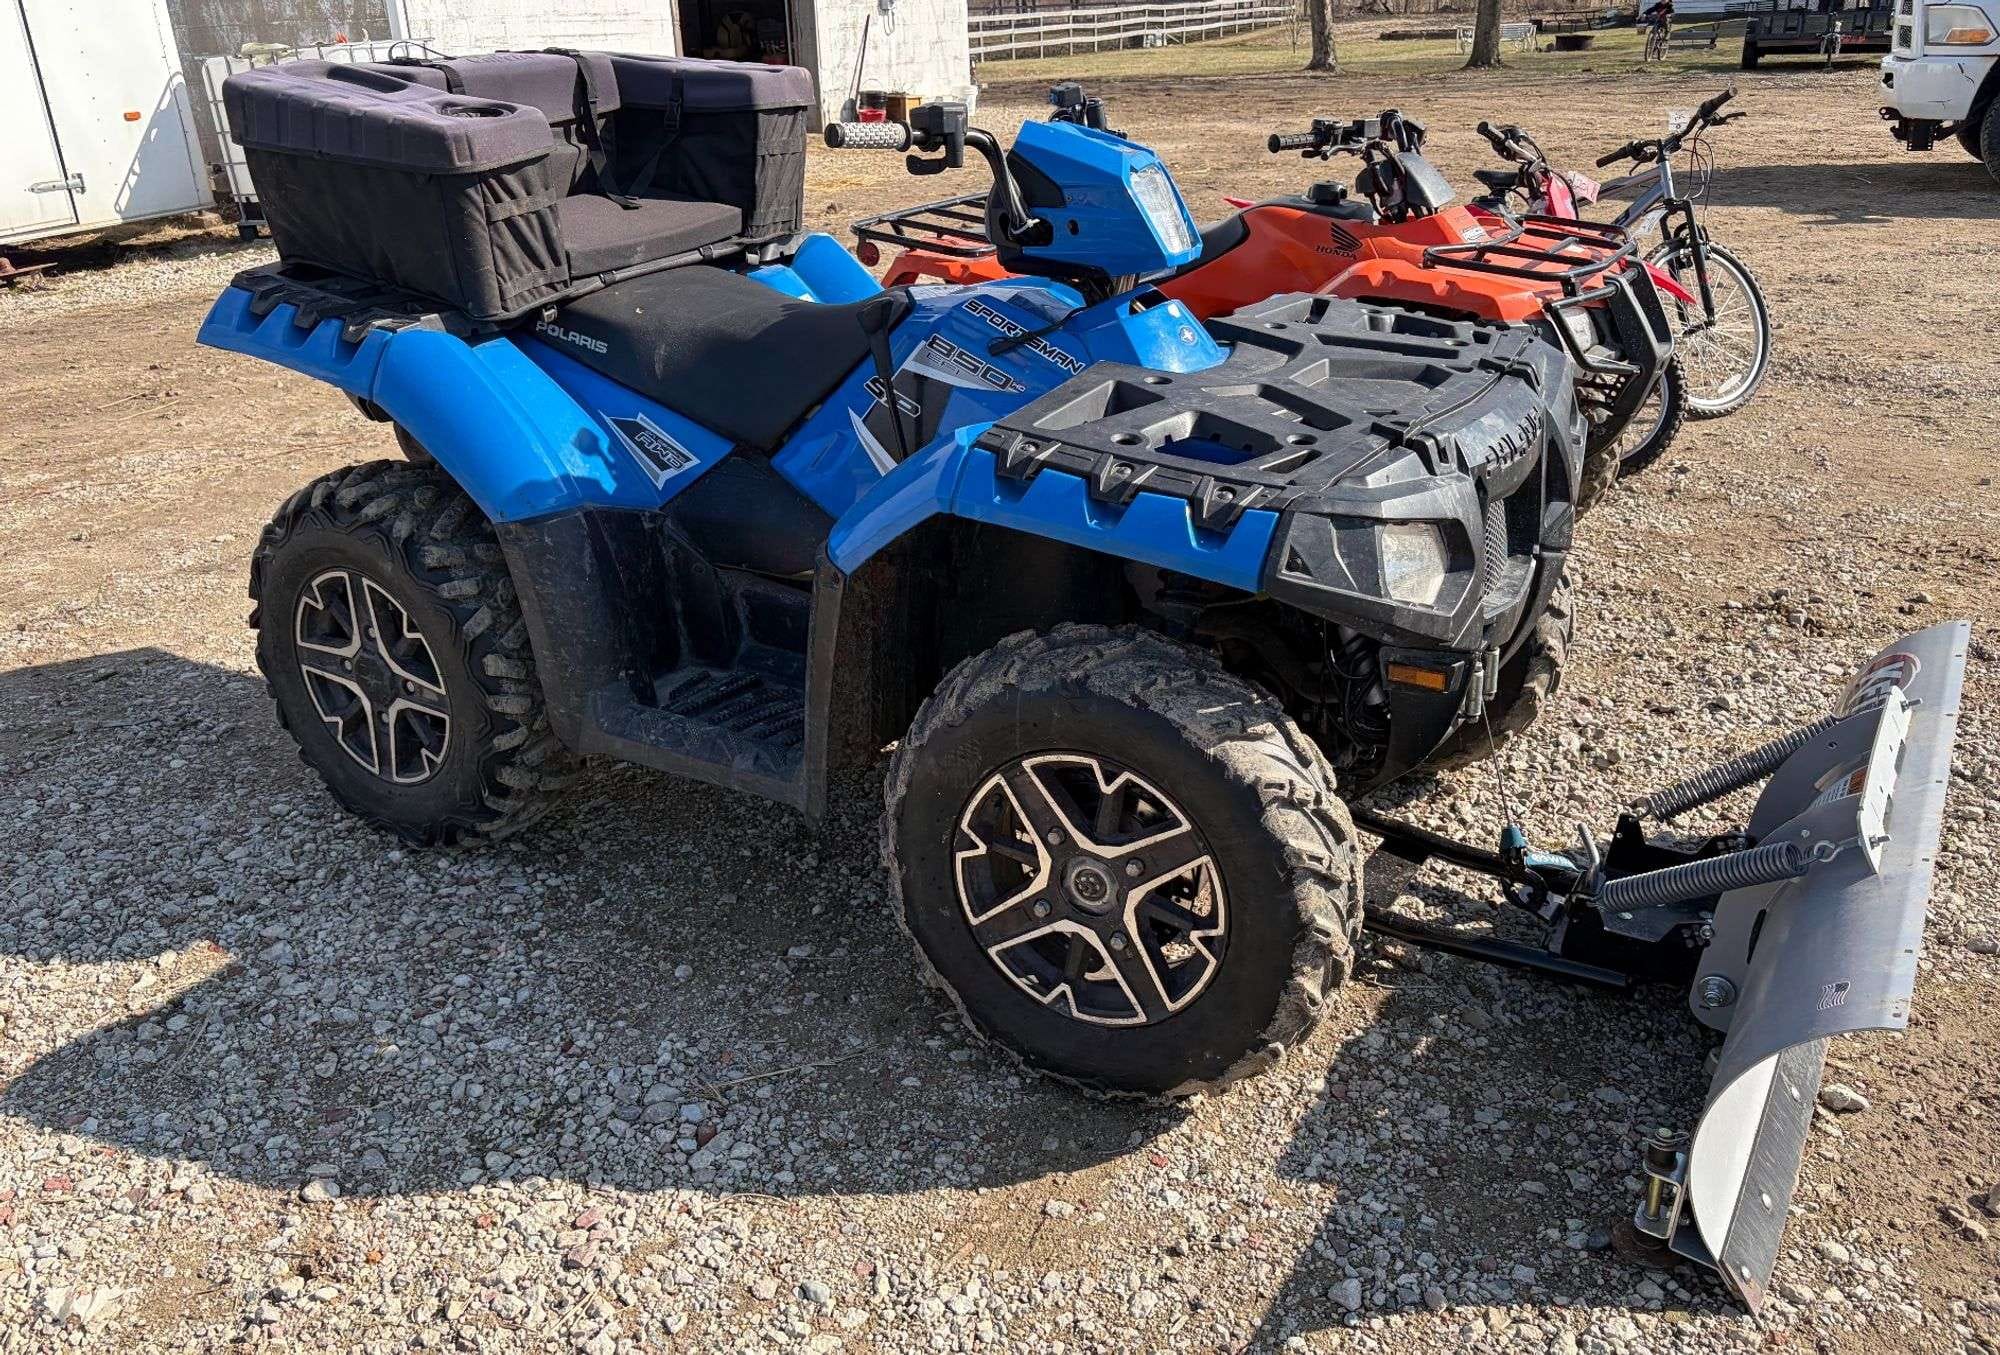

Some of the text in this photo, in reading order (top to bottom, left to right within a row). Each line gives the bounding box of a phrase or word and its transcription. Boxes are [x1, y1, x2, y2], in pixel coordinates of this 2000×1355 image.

[1314, 244, 1358, 261] HONDA
[535, 320, 609, 354] POLARIS
[962, 299, 1086, 376] SPORTSMAN
[926, 333, 1013, 391] 850
